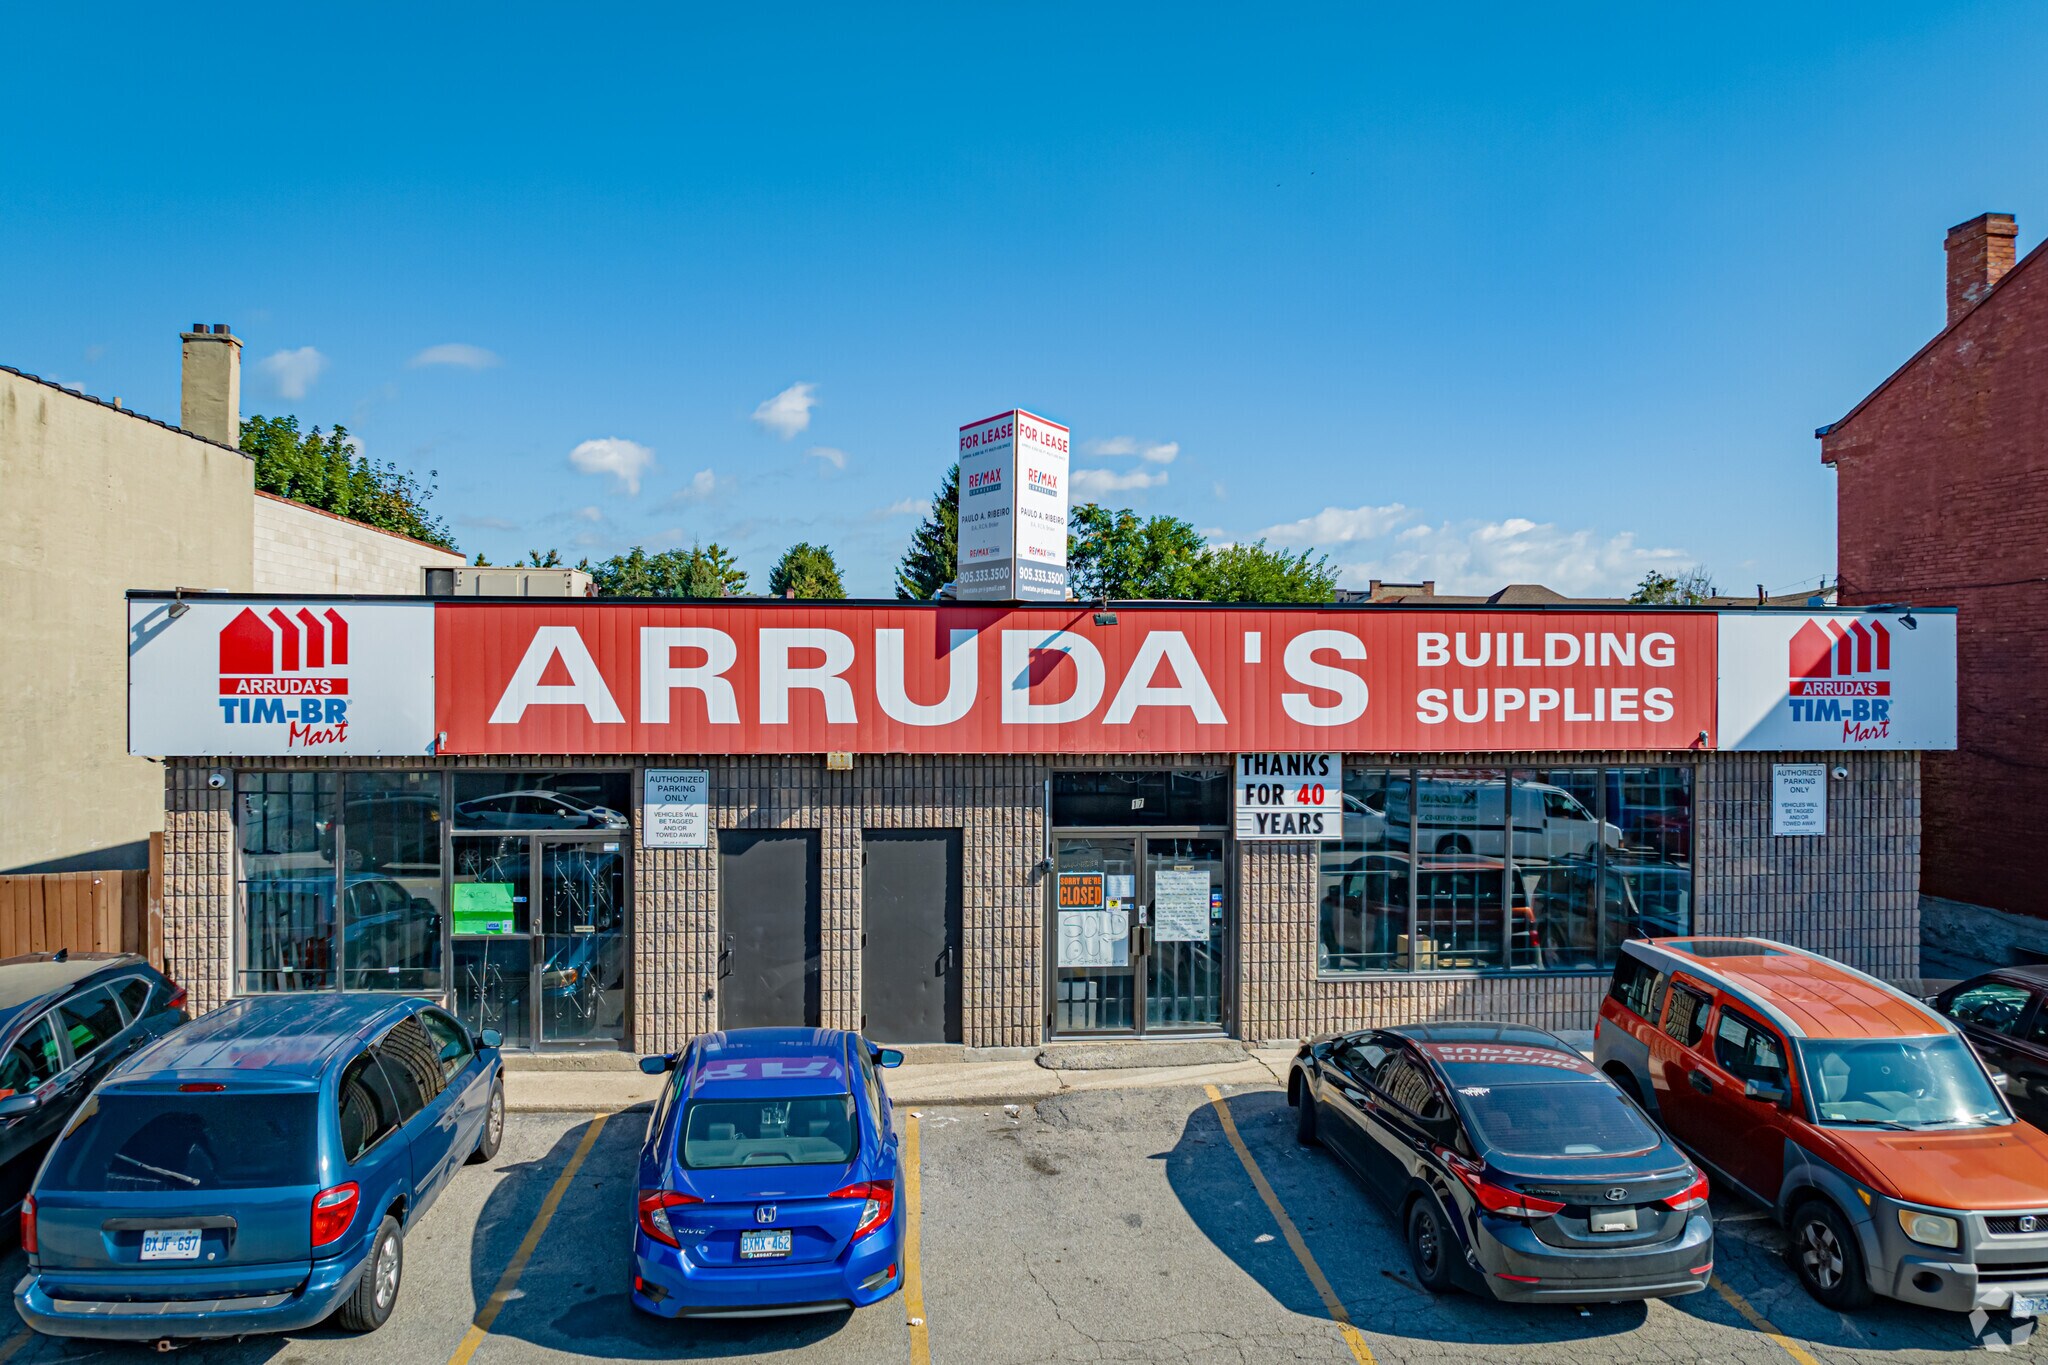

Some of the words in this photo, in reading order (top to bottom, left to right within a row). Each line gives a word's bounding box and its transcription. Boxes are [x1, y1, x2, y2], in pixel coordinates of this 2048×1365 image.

[960, 434, 979, 451] FOR
[982, 423, 1013, 445] LEASE
[1020, 423, 1037, 442] FOR
[1041, 431, 1068, 453] LEASE
[969, 467, 1001, 488] RE/MAX
[1028, 468, 1057, 489] RE/MAX
[961, 513, 979, 524] PAULO
[987, 507, 1010, 519] RIBEIRO
[1021, 507, 1037, 518] PAULO
[1045, 513, 1064, 525] RIBEIRO
[970, 548, 989, 558] RE/MAX
[1029, 546, 1046, 557] RE/MAX
[960, 567, 1010, 584] 905.333.3500
[1019, 566, 1064, 585] 905.333.3500
[1417, 632, 1676, 668] BUILDING
[488, 625, 1369, 727] ARRUDA'S
[236, 679, 332, 694] ARRUDA'S
[1802, 682, 1878, 695] ARRUDA'S
[1416, 687, 1675, 724] SUPPLIES
[288, 720, 348, 747] Mart
[1842, 719, 1890, 743] Mart
[1241, 754, 1329, 776] THANKS
[1777, 769, 1823, 777] AUTHORIZED
[665, 794, 688, 802] ONLY
[1245, 783, 1285, 806] FOR
[1297, 783, 1325, 806] 40
[1133, 800, 1143, 809] 17
[1256, 812, 1324, 835] YEARS
[1060, 877, 1081, 885] SORRY
[1082, 877, 1102, 885] WE'RE
[1060, 886, 1102, 905] CLOSED
